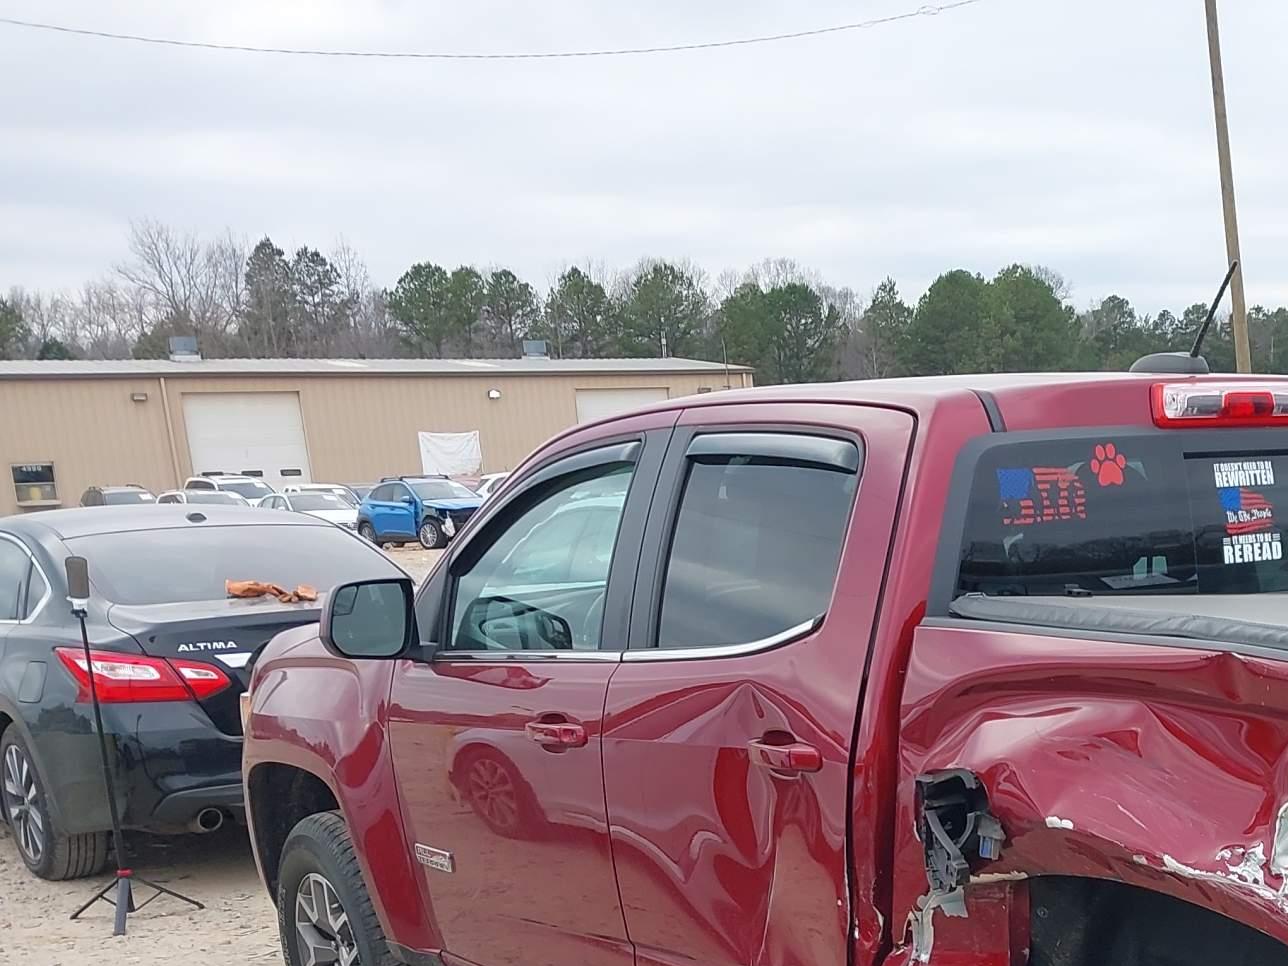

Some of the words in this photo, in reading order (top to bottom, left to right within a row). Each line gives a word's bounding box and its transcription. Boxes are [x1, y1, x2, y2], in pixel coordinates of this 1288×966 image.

[1214, 463, 1220, 472] IT
[1220, 462, 1242, 472] DOESN'T
[1243, 461, 1256, 471] NEED
[1257, 461, 1264, 470] TO
[1214, 469, 1275, 488] REWRITTEN
[1226, 510, 1238, 524] We
[1251, 508, 1272, 521] People
[1232, 535, 1239, 545] IT
[1239, 534, 1256, 544] NEEDS
[1256, 533, 1264, 543] TO
[1223, 541, 1282, 564] REREAD
[177, 640, 238, 653] ALTIMA
